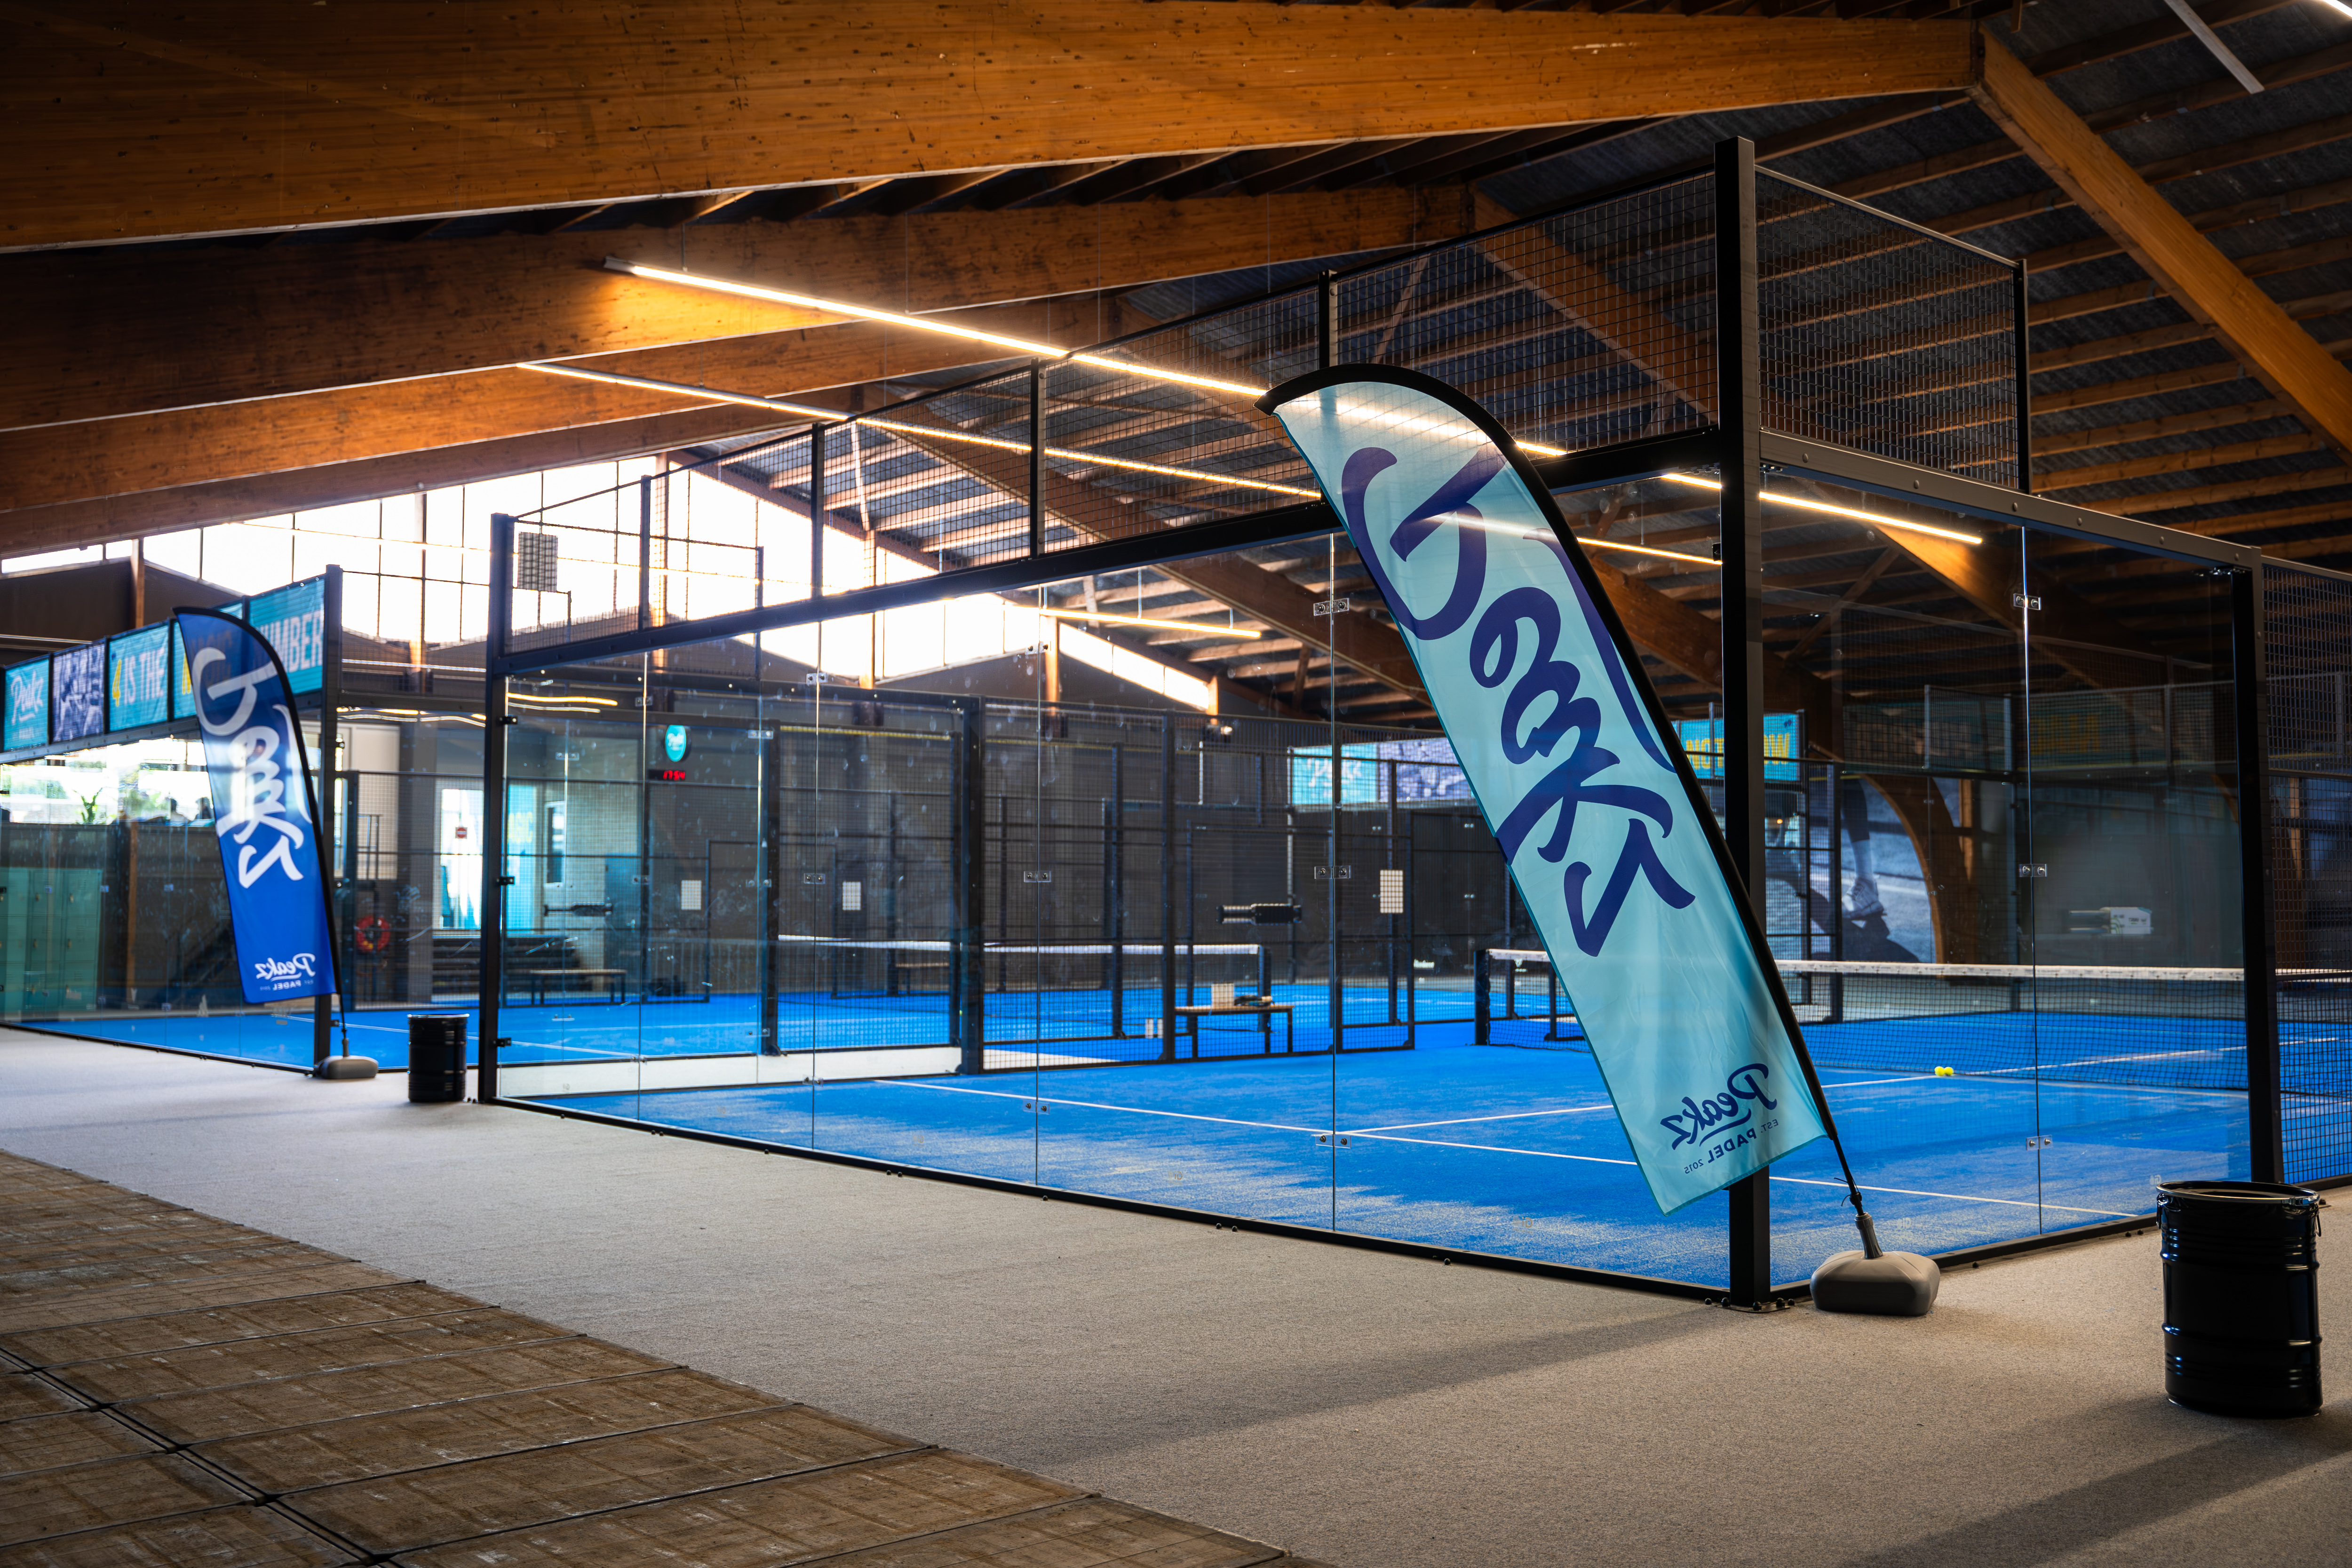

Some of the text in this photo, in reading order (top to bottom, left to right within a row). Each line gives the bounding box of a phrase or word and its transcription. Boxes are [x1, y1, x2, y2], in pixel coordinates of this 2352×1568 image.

[112, 659, 122, 707] 4
[124, 654, 136, 705] IS
[139, 646, 164, 701] THE
